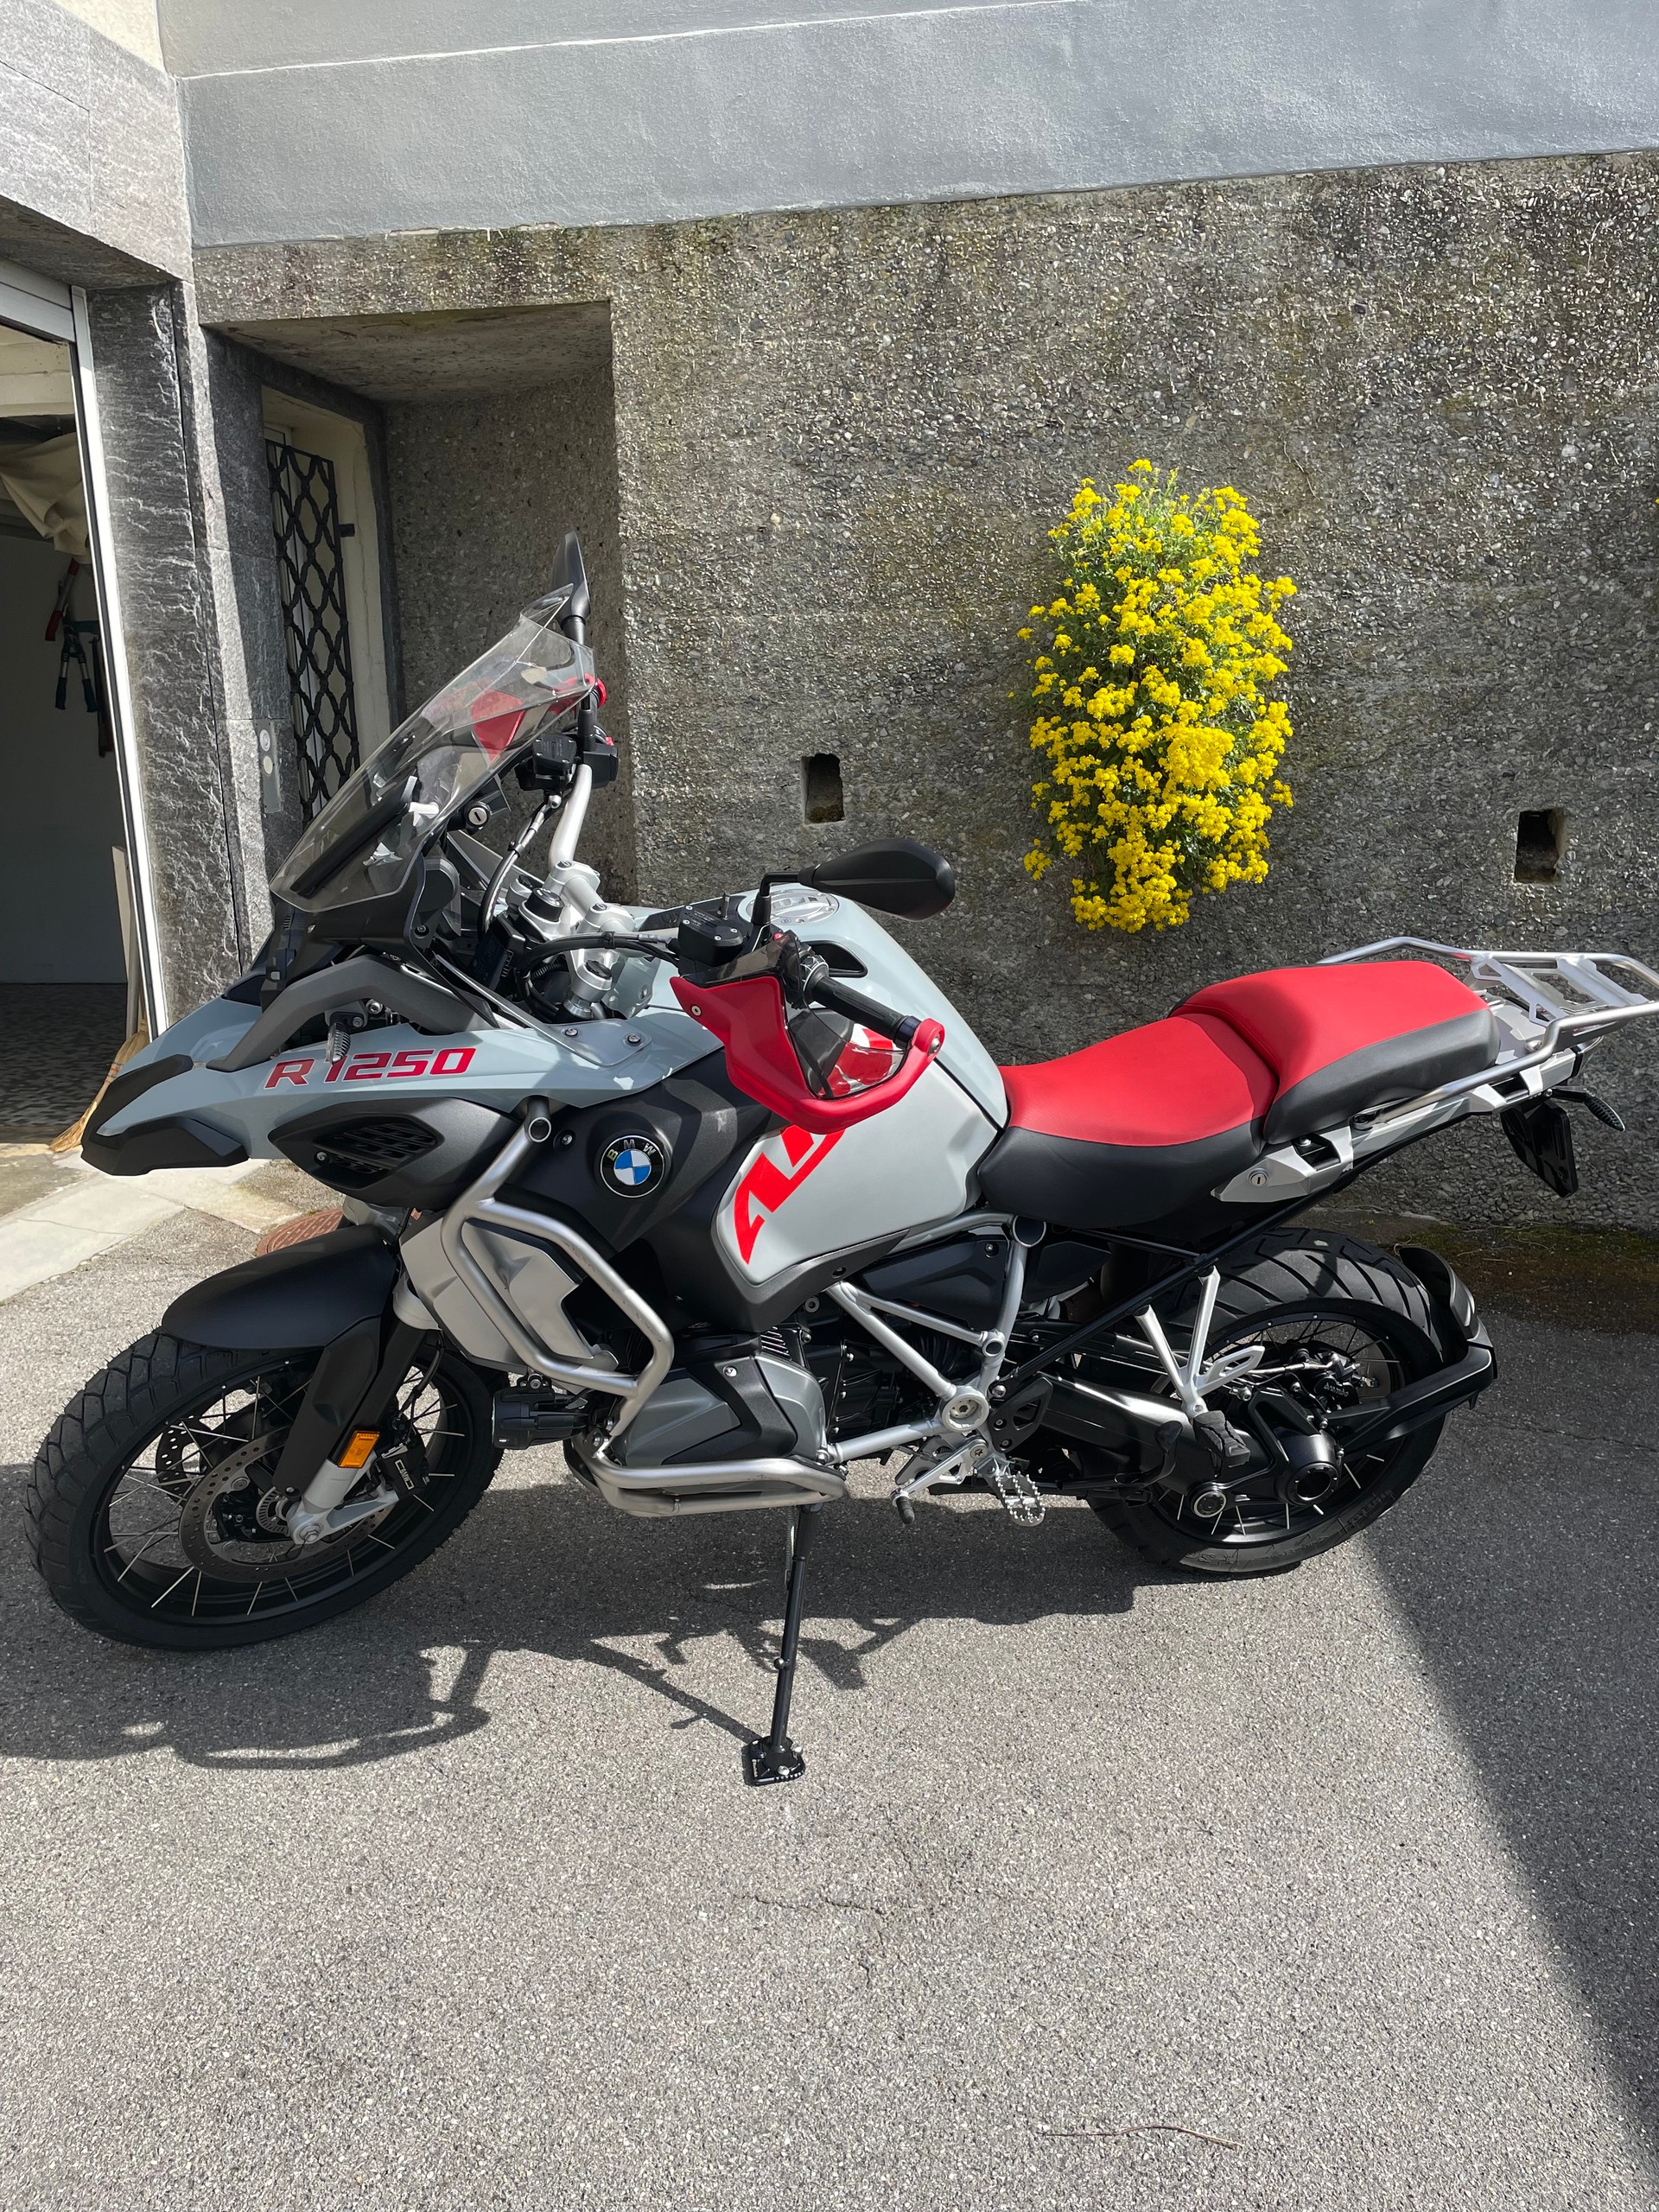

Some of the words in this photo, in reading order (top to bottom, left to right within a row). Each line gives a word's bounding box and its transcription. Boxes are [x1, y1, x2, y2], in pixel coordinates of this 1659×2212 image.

[264, 1058, 315, 1090] R
[324, 1047, 476, 1083] 1250
[607, 1139, 657, 1161] BMW
[1323, 1382, 1350, 1397] brembo
